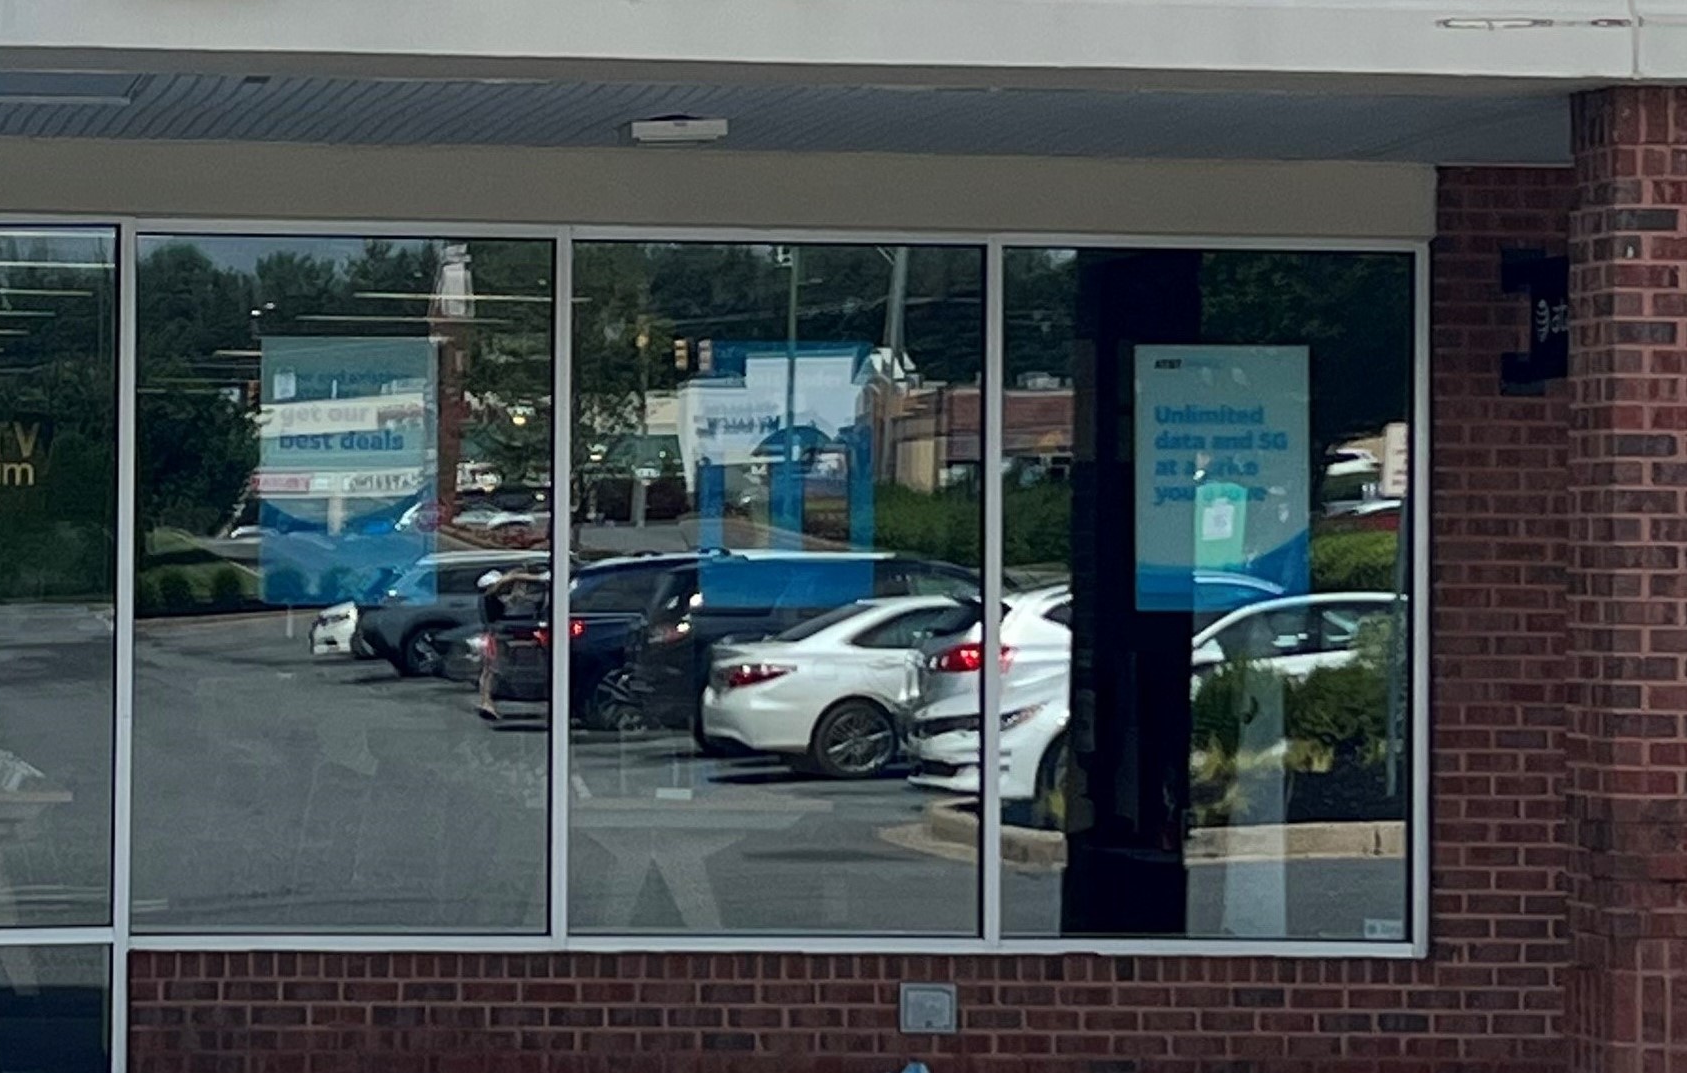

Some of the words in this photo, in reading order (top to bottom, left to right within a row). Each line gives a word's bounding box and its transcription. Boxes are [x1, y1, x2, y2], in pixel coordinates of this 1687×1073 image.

[280, 406, 323, 428] get
[328, 406, 371, 423] our
[1154, 404, 1264, 425] Unlimited
[340, 430, 404, 451] deals
[1154, 430, 1205, 450] data
[1212, 431, 1253, 450] and
[1259, 431, 1288, 451] 5G
